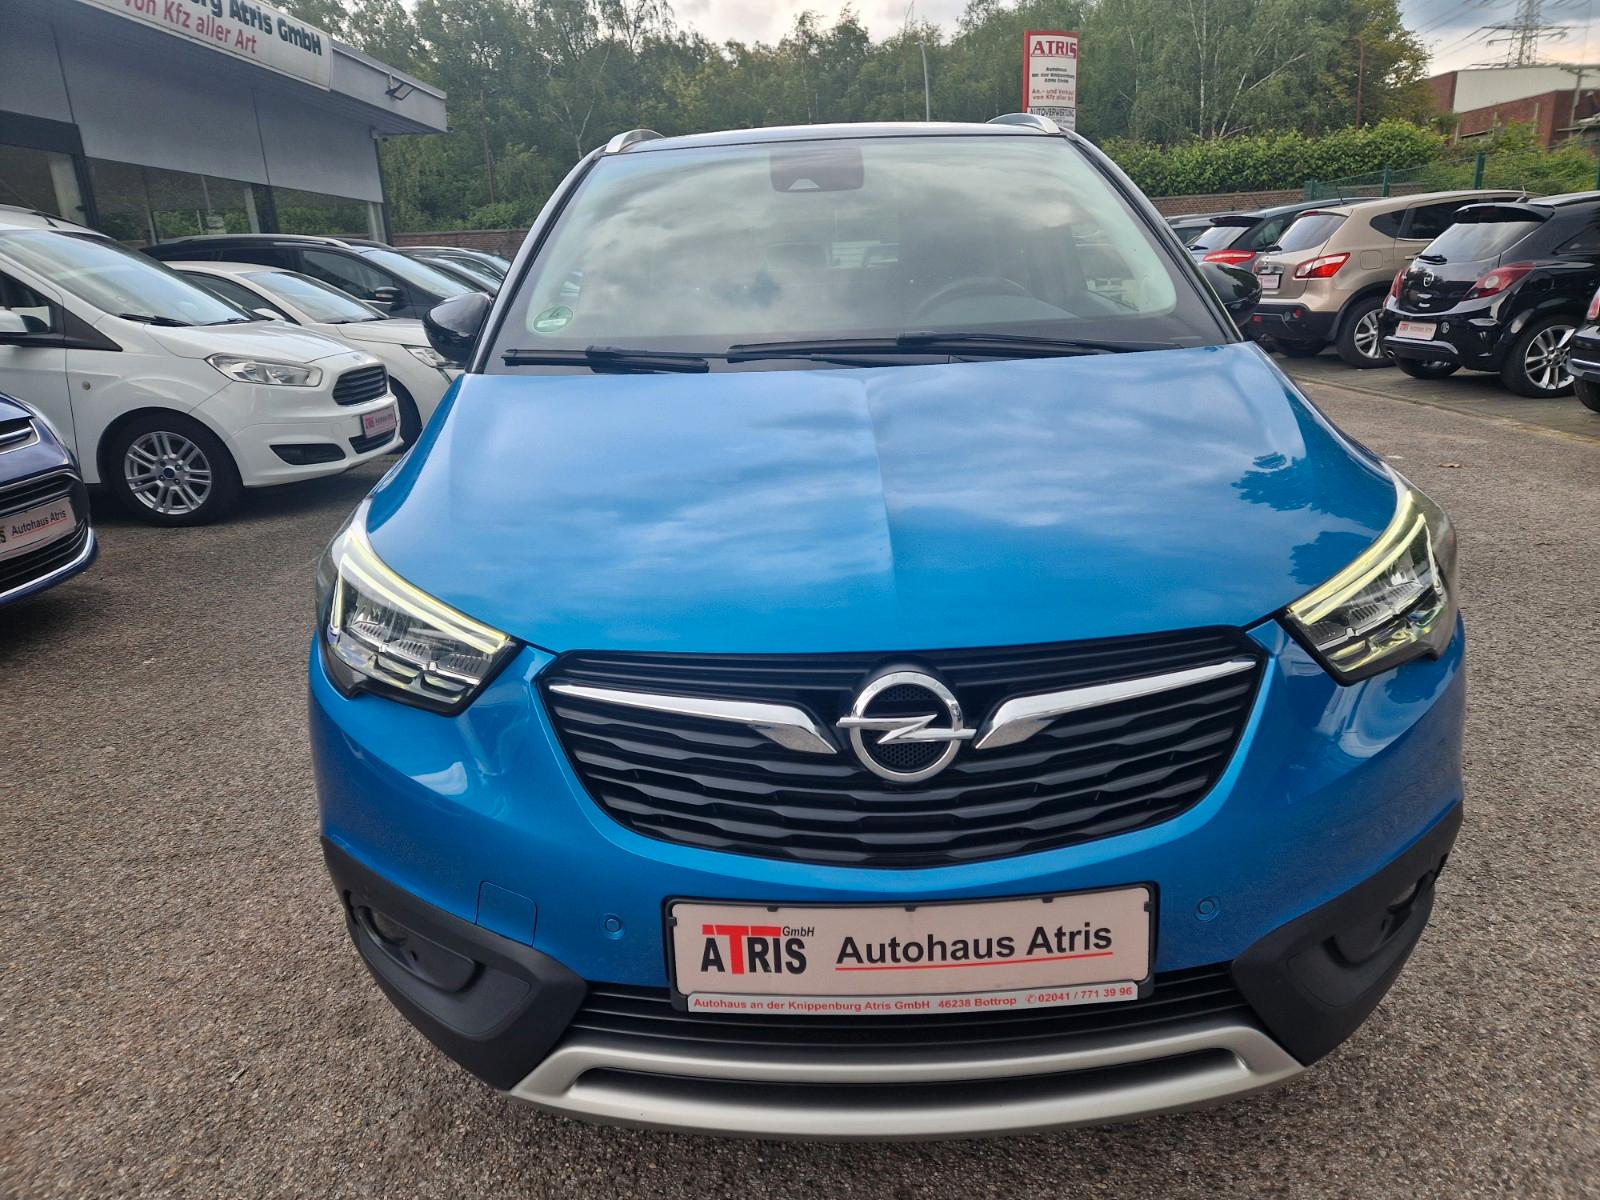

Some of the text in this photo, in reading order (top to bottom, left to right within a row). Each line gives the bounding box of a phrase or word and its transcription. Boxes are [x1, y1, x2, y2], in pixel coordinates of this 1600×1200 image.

[164, 0, 191, 28] Kfz
[196, 15, 231, 43] aller
[234, 28, 257, 54] Art
[228, 1, 273, 35] Atris
[277, 17, 322, 56] GmbH
[1031, 40, 1077, 59] ATRIS
[11, 517, 49, 536] Autohaus
[50, 510, 67, 521] Atris
[701, 924, 807, 975] ATRIS
[782, 926, 815, 938] GmbH
[836, 921, 1113, 965] Autohaus Atris
[693, 998, 747, 1009] Autohaus
[750, 1001, 763, 1009] an
[766, 1000, 784, 1010] der
[788, 1001, 862, 1012] Knippenburg
[864, 1000, 891, 1011] Atris
[894, 1001, 930, 1011] GmbH
[938, 999, 971, 1009] 46238
[974, 996, 1017, 1008] Bottrop
[1038, 992, 1070, 1004] 02041
[1080, 990, 1099, 1000] 771
[1103, 988, 1116, 998] 39
[1119, 986, 1133, 996] 96
